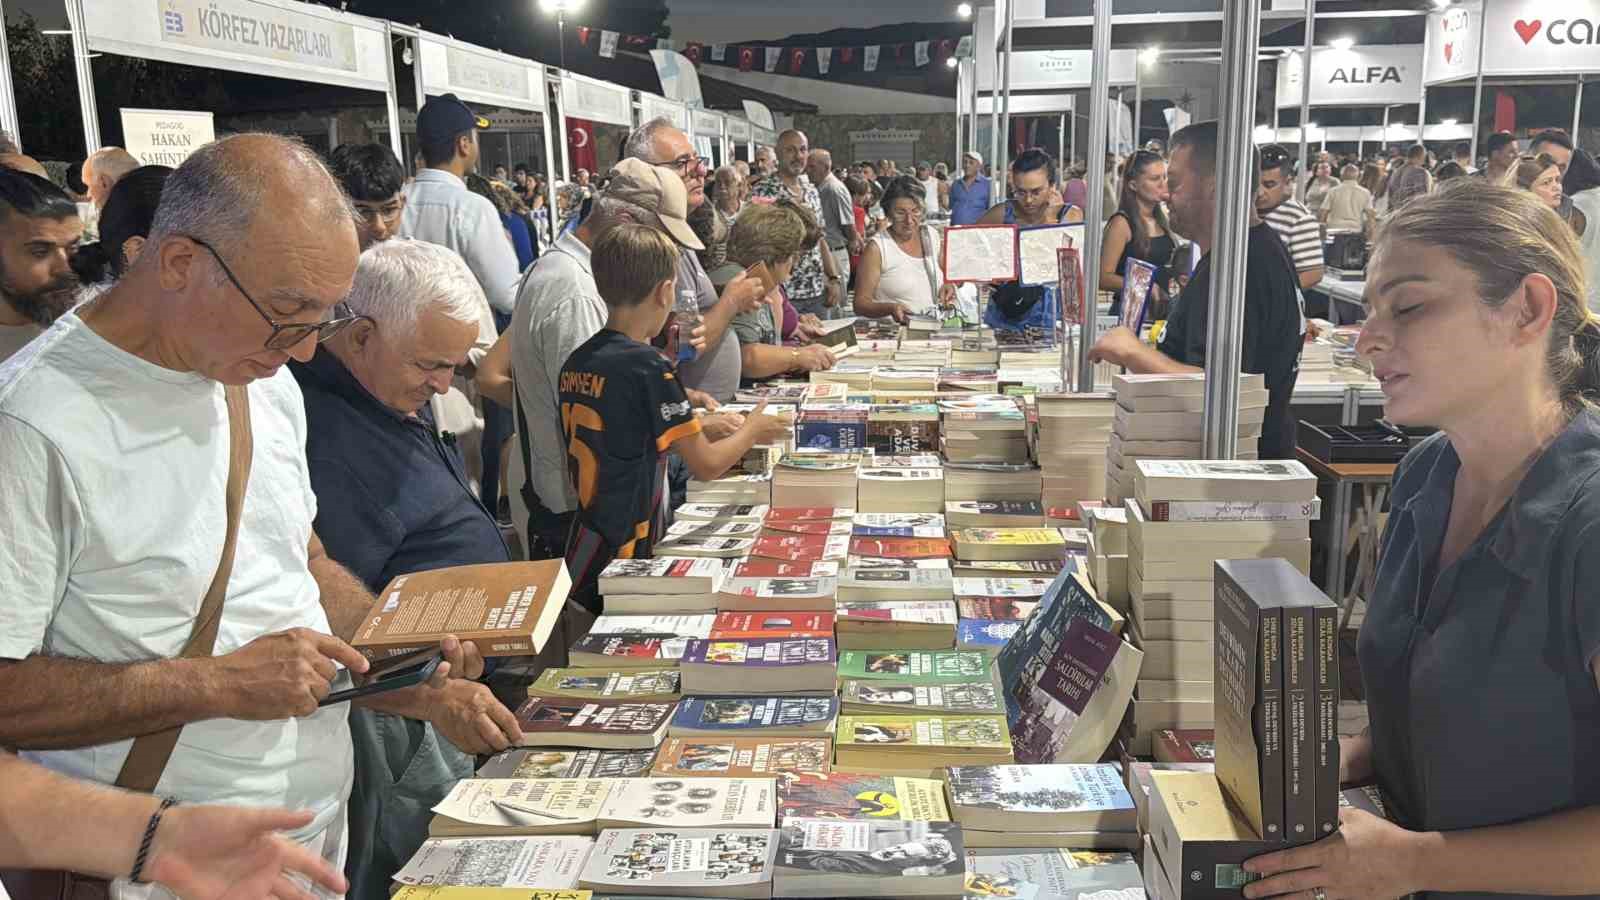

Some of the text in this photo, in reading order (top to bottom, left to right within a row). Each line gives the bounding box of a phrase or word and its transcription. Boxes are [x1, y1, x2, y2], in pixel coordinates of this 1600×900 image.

[198, 2, 333, 59] KÖRFEZ YAZARLARI
[1546, 19, 1600, 45] ca
[1329, 66, 1402, 84] ALFA
[151, 133, 191, 146] HAKAN
